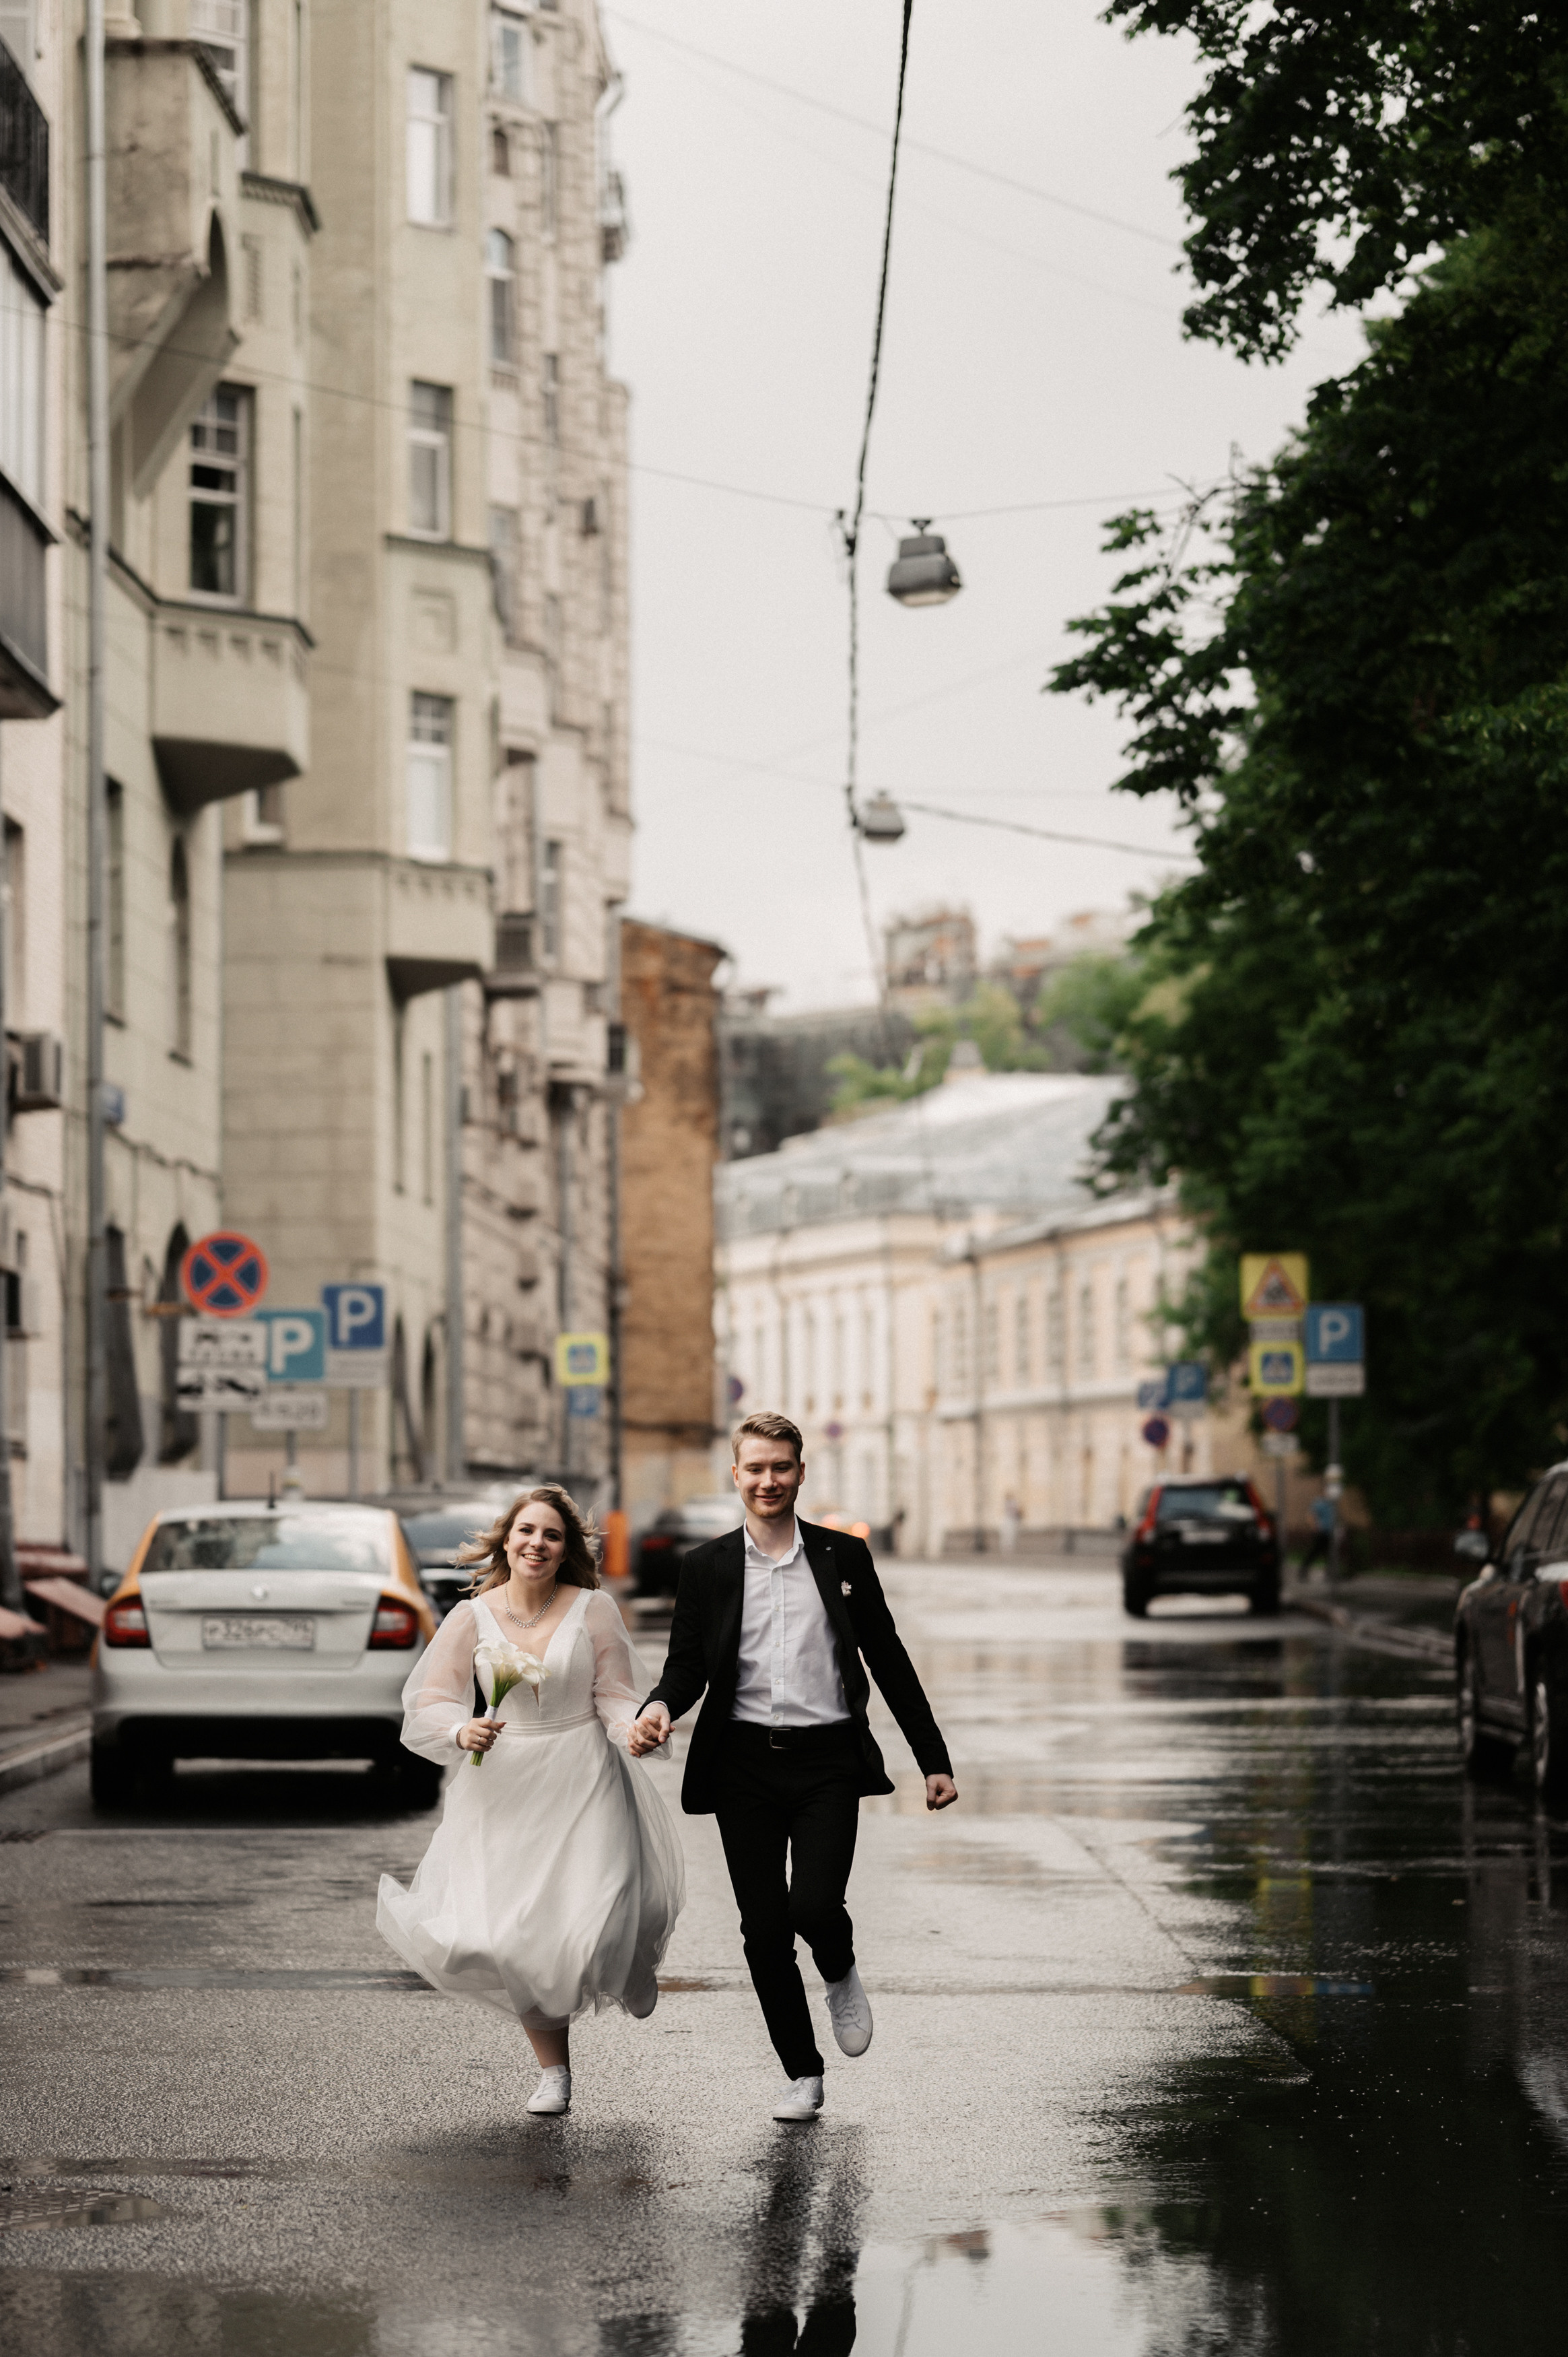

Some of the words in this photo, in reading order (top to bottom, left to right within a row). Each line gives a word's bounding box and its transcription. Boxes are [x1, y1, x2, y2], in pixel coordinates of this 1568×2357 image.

[338, 1290, 376, 1343] P
[1318, 1310, 1350, 1354] P
[271, 1318, 314, 1374] P
